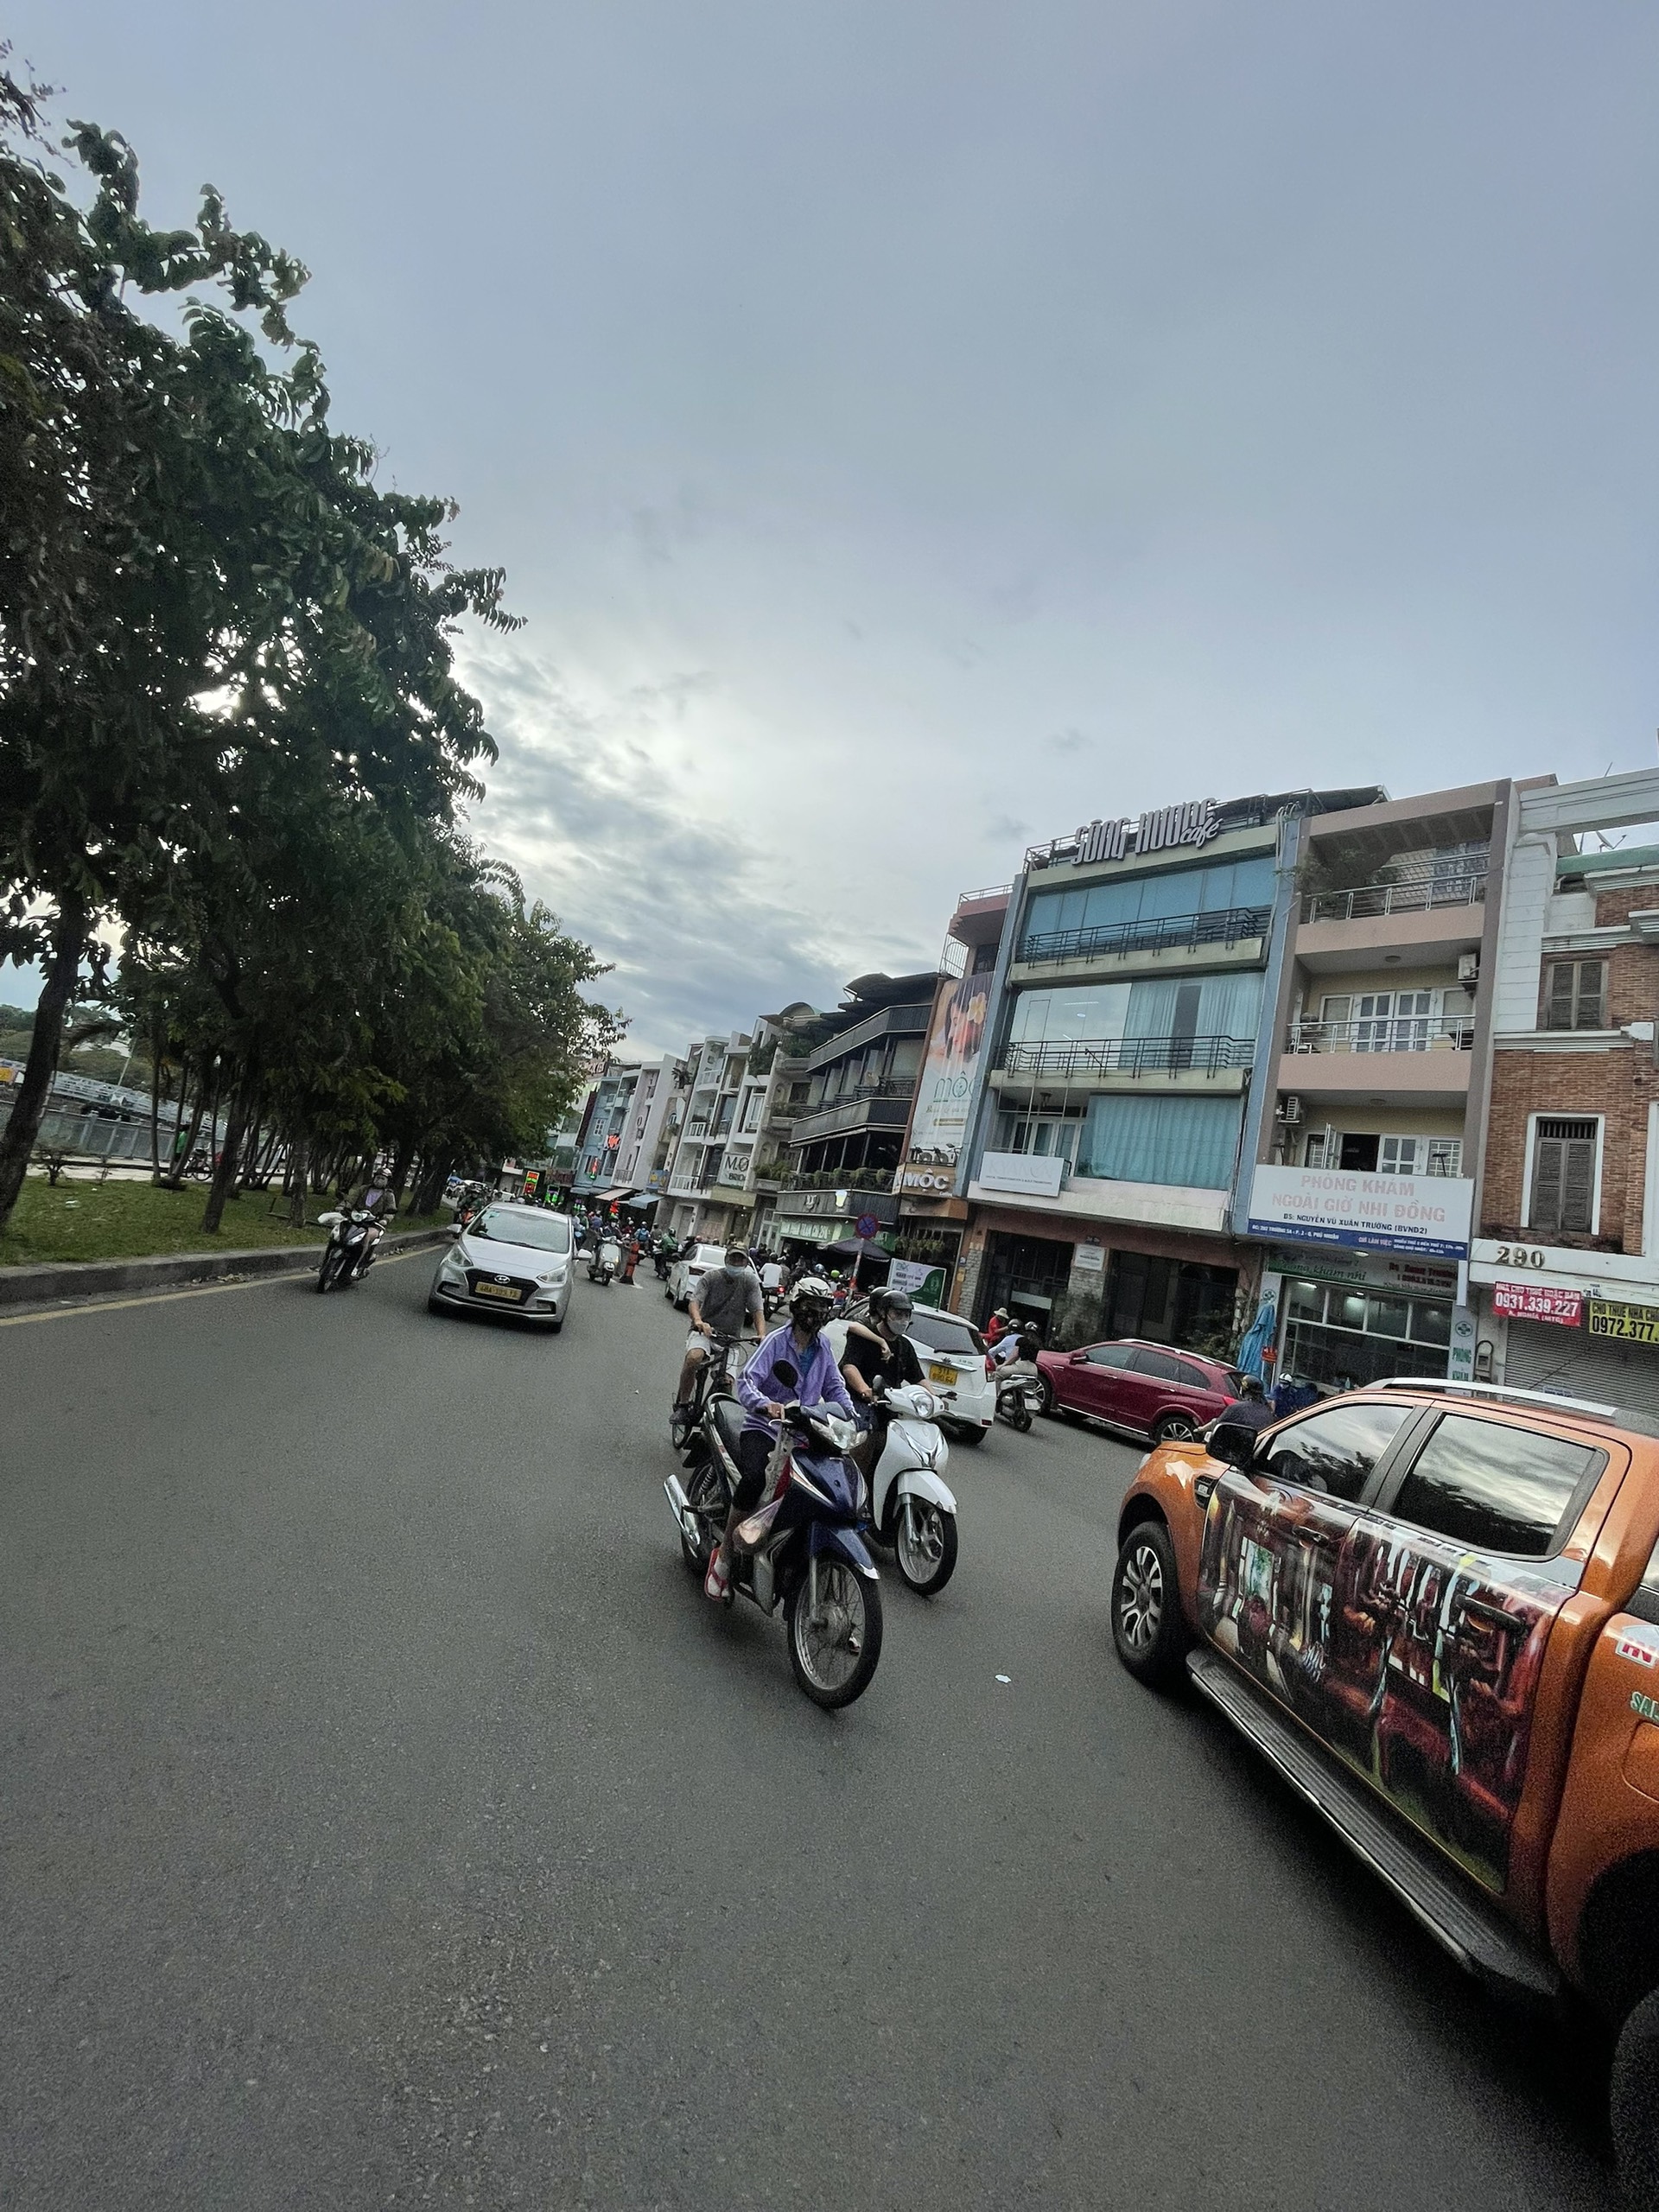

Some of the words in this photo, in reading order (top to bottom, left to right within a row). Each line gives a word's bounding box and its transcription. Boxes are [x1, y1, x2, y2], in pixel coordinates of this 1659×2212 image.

[1071, 817, 1131, 864] SÔNG
[1179, 810, 1224, 848] café
[903, 1167, 950, 1192] MỘC
[1300, 1173, 1357, 1192] PHÒNG
[1362, 1178, 1414, 1197] KHÁM
[1272, 1192, 1319, 1210] NGOÀI
[1324, 1195, 1354, 1213] GIỜ
[1358, 1201, 1389, 1217] NHI
[1394, 1199, 1446, 1223] ĐỒNG
[1296, 1212, 1325, 1224] NGUYỄN
[1338, 1217, 1359, 1227] XUÂN
[1361, 1220, 1392, 1231] TRƯỜNG
[1495, 1246, 1545, 1268] 290
[1495, 1292, 1580, 1317] 0931.339.227
